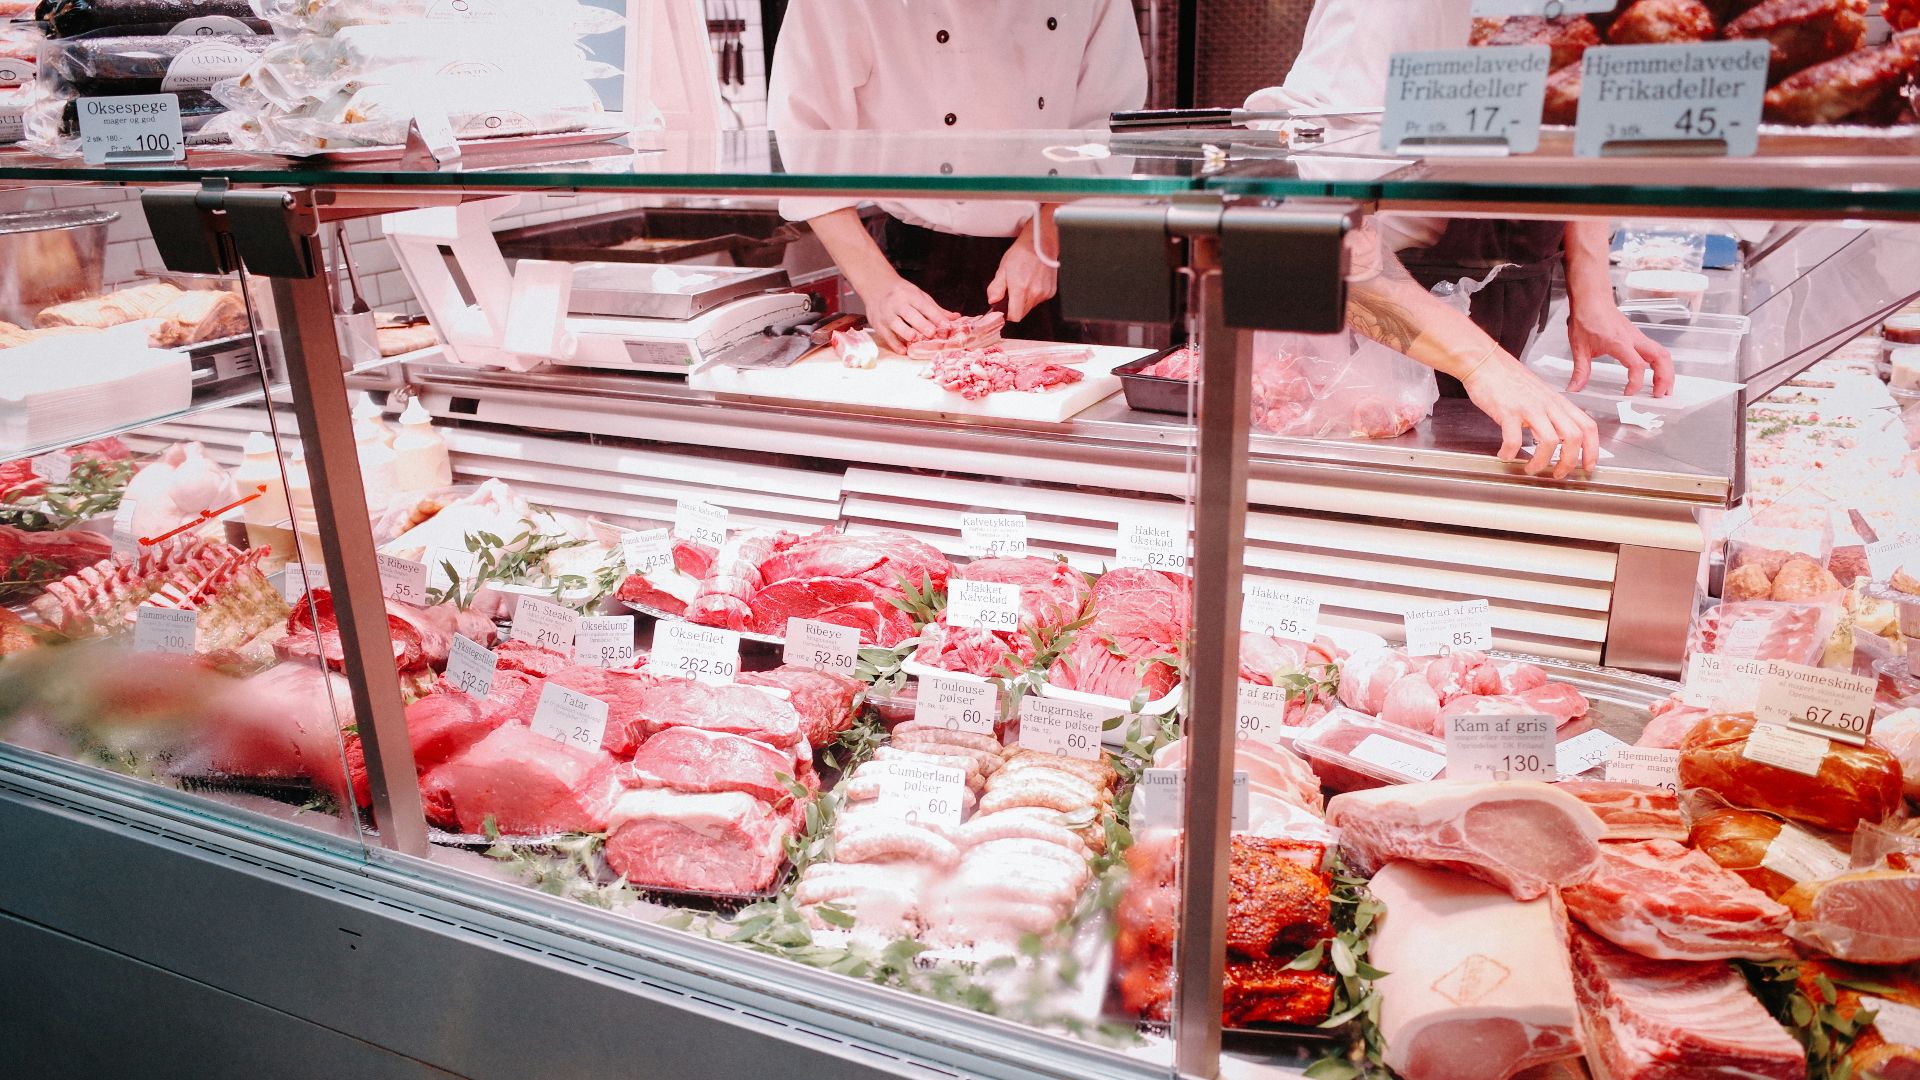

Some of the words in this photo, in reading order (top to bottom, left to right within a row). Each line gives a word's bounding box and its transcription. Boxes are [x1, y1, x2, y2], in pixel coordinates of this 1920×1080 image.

[1389, 53, 1547, 79] Hjemmelavede
[1585, 50, 1767, 77] Hjemmelavede
[1401, 79, 1528, 101] Frikadeller
[1599, 77, 1746, 101] Frikadeller
[87, 101, 168, 115] Oksespege
[142, 116, 156, 124] god
[1465, 106, 1520, 136] 17,-
[1675, 106, 1742, 138] 45,-
[136, 133, 182, 151] 100,-
[963, 516, 1025, 528] Kalvetykkam
[696, 527, 723, 545] 52,50
[1135, 525, 1170, 538] Hakket
[991, 540, 1025, 553] 67,50
[387, 557, 421, 575] Ribeye
[1148, 552, 1185, 568] 62,50
[395, 583, 420, 600] 55,-
[966, 582, 1001, 595] Hakket
[1251, 585, 1290, 602] Hakket
[1293, 594, 1316, 606] gris
[138, 609, 195, 623] Lammeculotte
[522, 599, 541, 613] Frb.
[542, 605, 574, 623] Steaks
[980, 609, 1017, 625] 62,50
[1406, 608, 1451, 621] Mørbrad
[1454, 605, 1465, 616] af
[1468, 603, 1489, 615] gris
[581, 620, 629, 634] Okseklump
[669, 626, 725, 645] Oksefilet
[806, 623, 843, 640] Ribeye
[1279, 618, 1309, 636] 55,-
[164, 634, 193, 651] 100,-
[1453, 631, 1484, 646] 85,-
[601, 645, 633, 661] 92,50
[814, 650, 852, 668] 52,50
[679, 656, 734, 677] 262,50
[462, 670, 489, 695] 132,50
[933, 678, 985, 696] Toulouse
[1768, 664, 1873, 697] Bayonneskinke
[563, 692, 589, 710] Tatar
[939, 692, 976, 706] pølser
[1247, 687, 1259, 698] af
[1262, 690, 1285, 702] gris
[963, 709, 992, 727] 60,-
[1032, 700, 1094, 721] Ungarnske
[1023, 713, 1062, 727] stærke
[1065, 719, 1101, 734] pølser
[1240, 715, 1271, 734] 90,-
[1454, 718, 1489, 733] Kam
[1495, 718, 1511, 733] af
[1516, 718, 1548, 734] gris
[572, 726, 599, 746] 25,-
[1068, 733, 1098, 752] 60,-
[888, 763, 960, 784] Cumberland
[1503, 755, 1556, 775] 130,-
[1606, 759, 1635, 770] Pølser
[928, 798, 959, 818] 60,-
